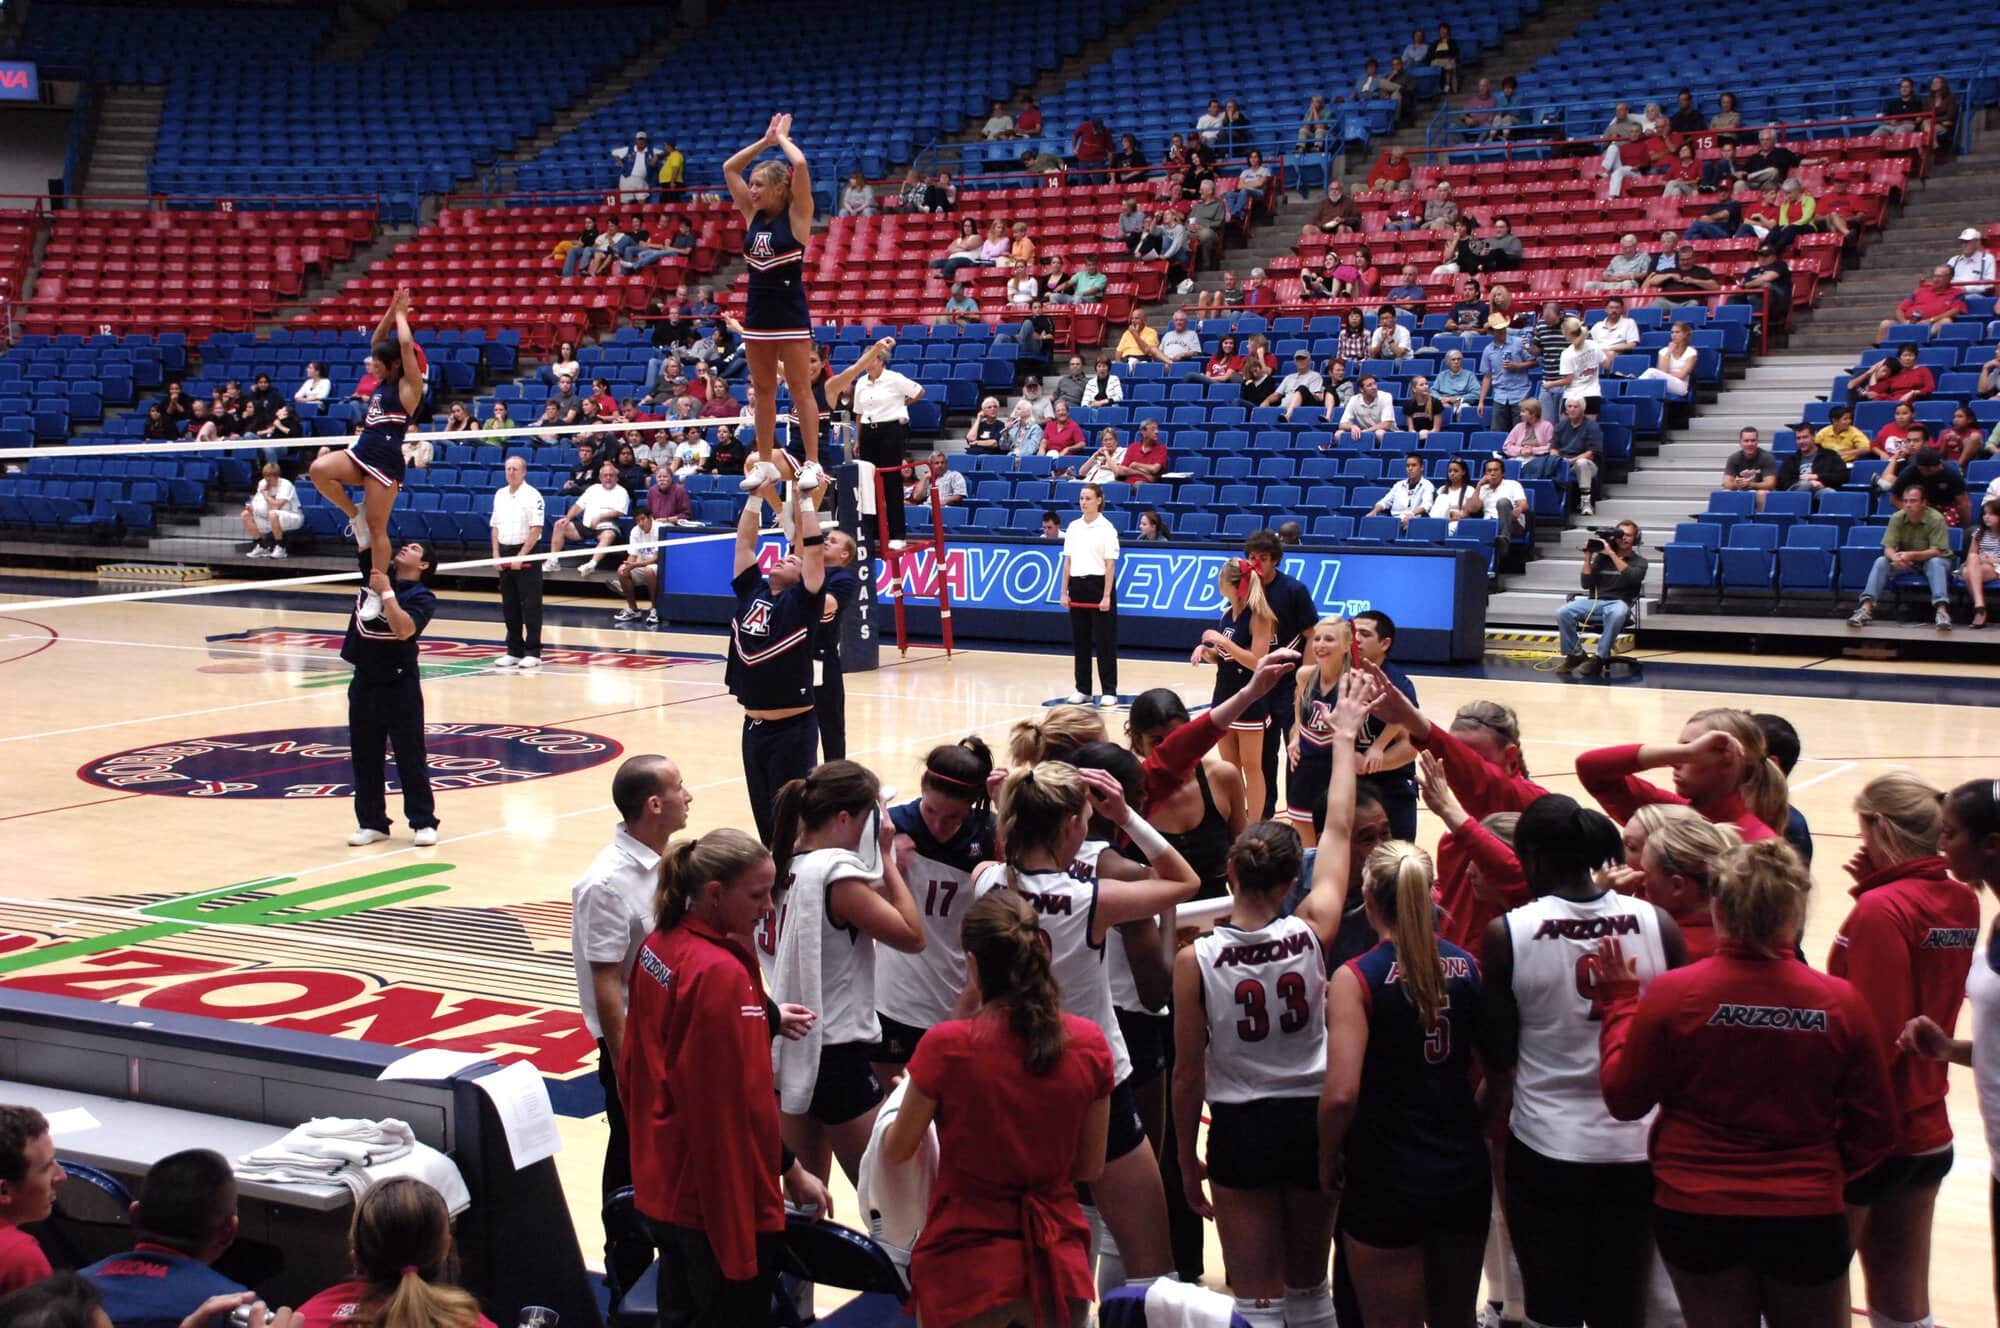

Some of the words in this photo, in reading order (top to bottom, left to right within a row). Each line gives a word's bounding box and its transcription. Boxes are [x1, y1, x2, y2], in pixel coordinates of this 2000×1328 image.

[1697, 137, 1712, 149] 15
[1048, 177, 1058, 188] 14
[222, 201, 233, 212] 12
[607, 196, 616, 206] 13
[750, 232, 775, 257] A
[99, 325, 112, 336] 12
[740, 599, 775, 636] A
[925, 880, 958, 918] 17
[1532, 914, 1641, 941] ARIZONA
[1213, 931, 1314, 968] ARIZONA
[639, 945, 673, 991] ARIZONA
[1234, 971, 1310, 1042] 33
[1707, 1003, 1828, 1032] ARIZONA
[1423, 994, 1451, 1064] 5
